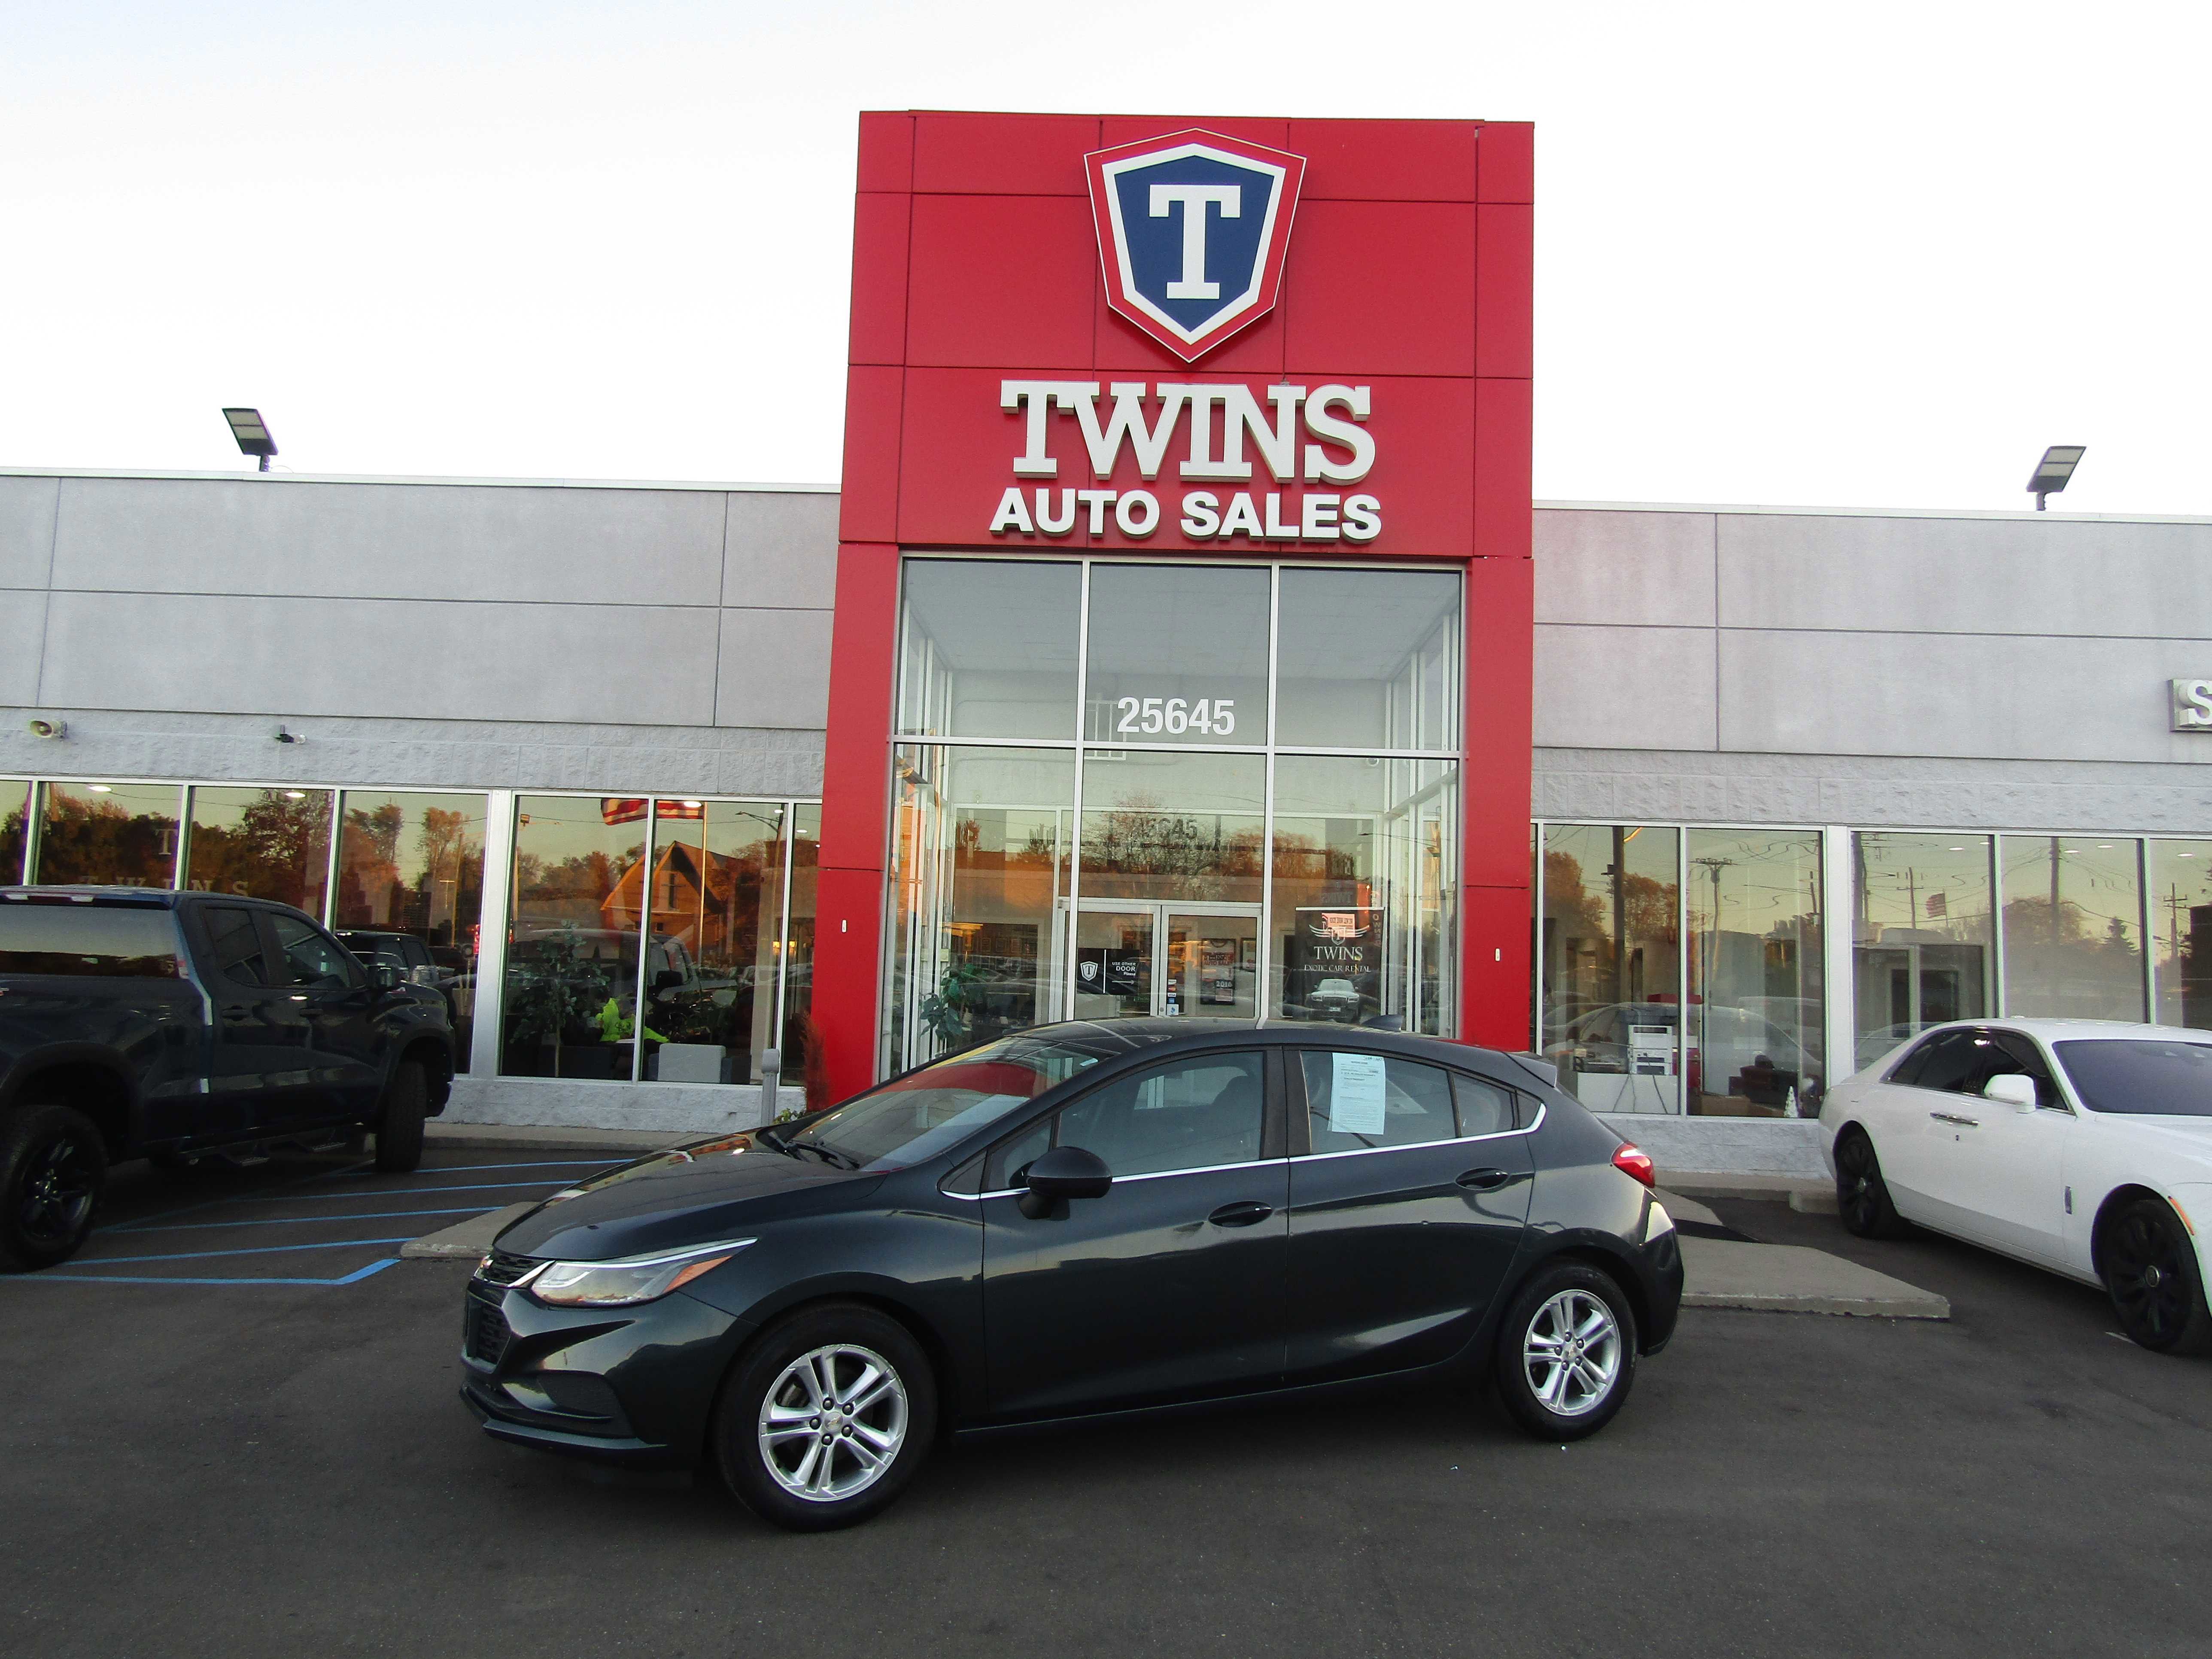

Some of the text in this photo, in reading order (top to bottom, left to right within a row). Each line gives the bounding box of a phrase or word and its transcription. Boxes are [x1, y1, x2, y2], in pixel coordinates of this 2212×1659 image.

[1149, 184, 1241, 299] T
[1000, 380, 1376, 486] TWINS
[989, 487, 1382, 544] AUTO SALES
[1117, 697, 1235, 735] 25645
[1313, 946, 1363, 961] TWINS
